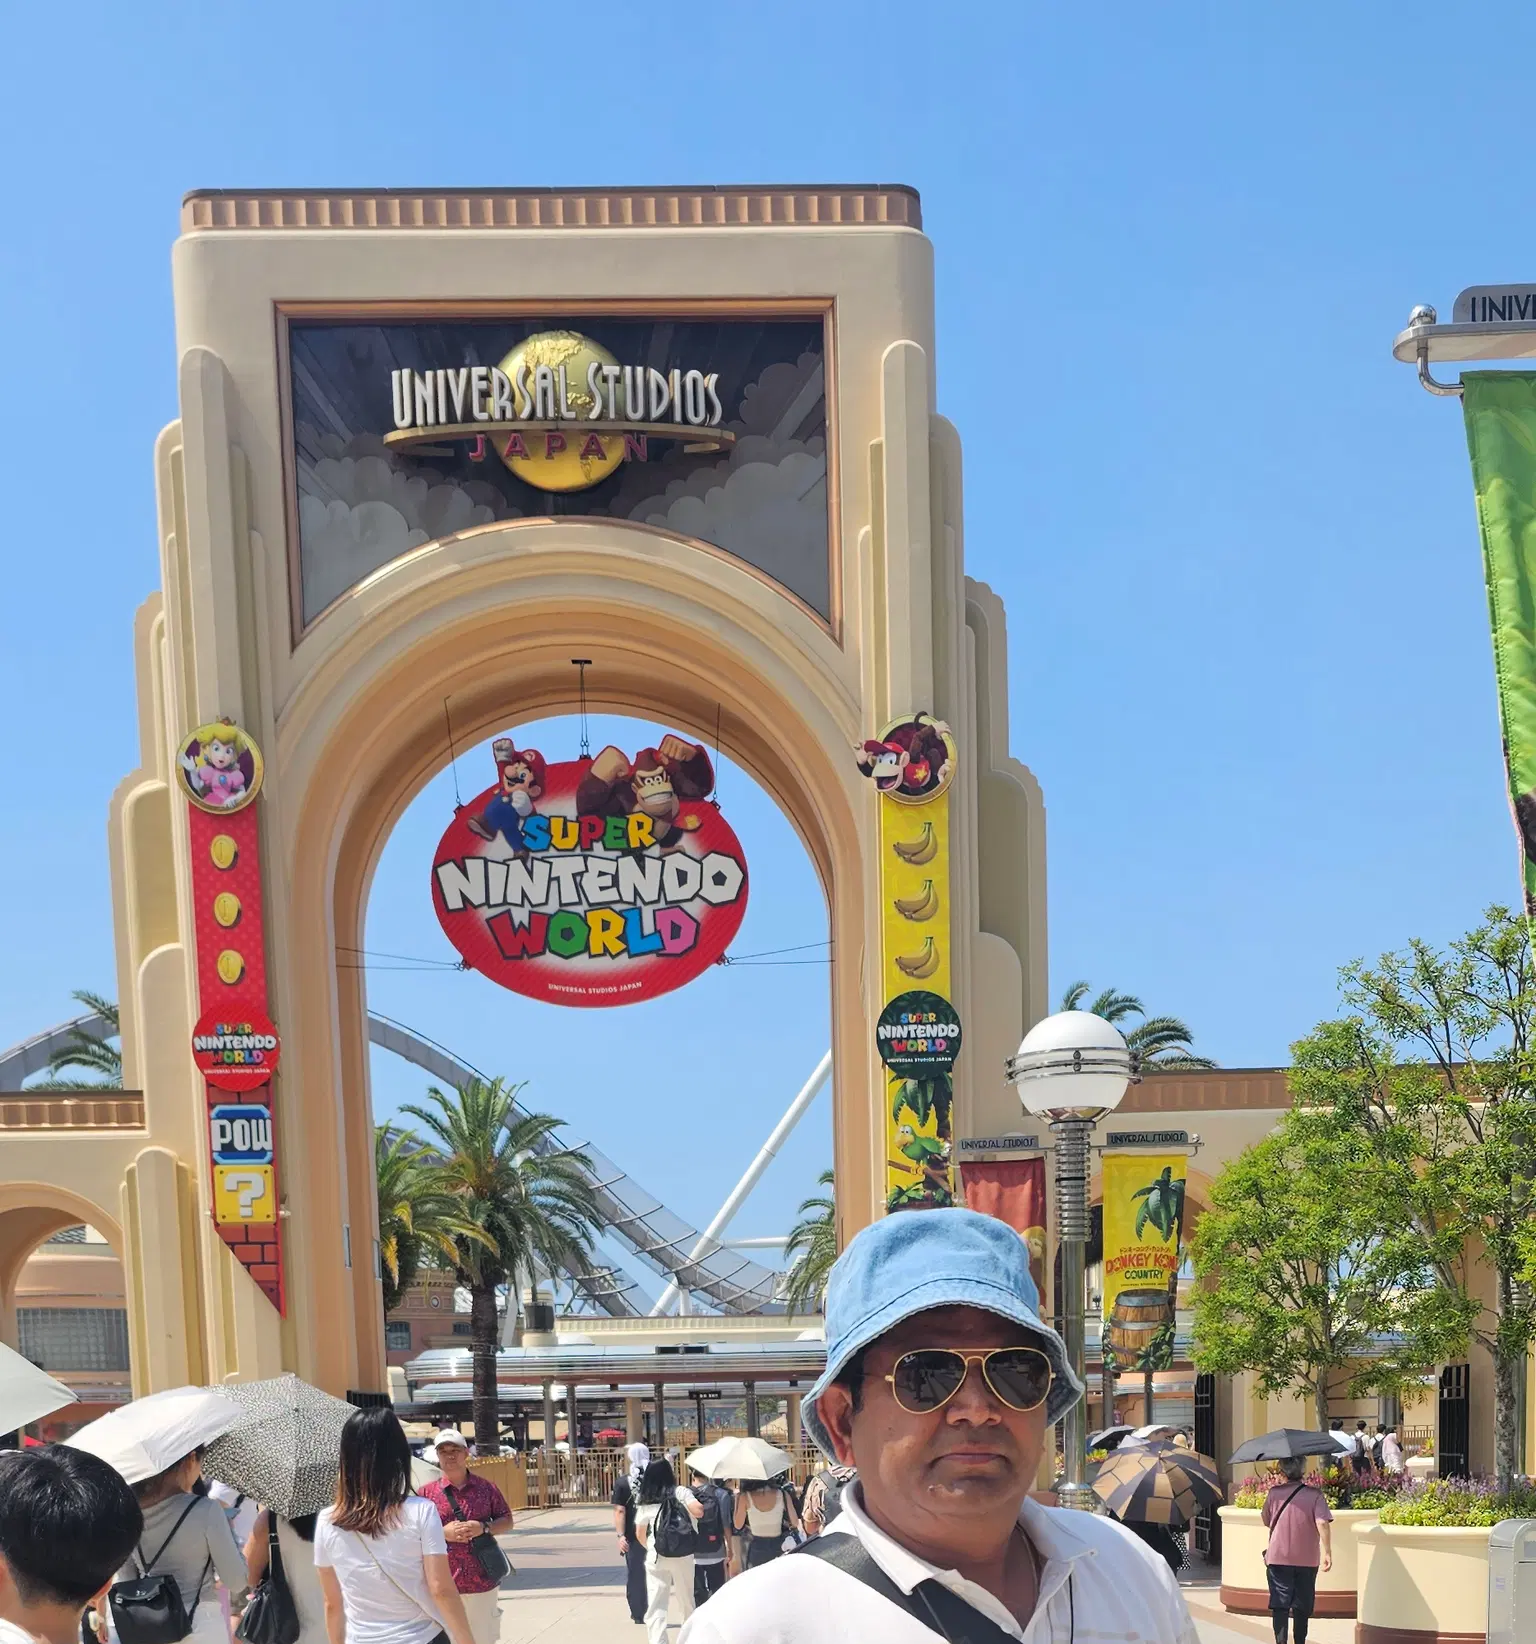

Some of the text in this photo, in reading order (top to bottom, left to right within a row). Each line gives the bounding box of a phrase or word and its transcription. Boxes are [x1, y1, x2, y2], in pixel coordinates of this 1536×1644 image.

[1471, 294, 1536, 322] UNIV
[391, 361, 723, 428] UNIVERSAL STUDIOS
[469, 432, 648, 462] JAPAN
[521, 812, 657, 852] SUPER
[433, 851, 746, 912] NINTENDO
[486, 906, 700, 960] WORLD
[548, 981, 642, 994] UNIVERSAL STUDIOS JAPAN
[901, 1012, 936, 1024] SUPER
[215, 1023, 253, 1035] SUPER
[878, 1024, 959, 1039] NINTENDO
[193, 1035, 277, 1051] NINTENDO
[890, 1038, 947, 1053] WORLD
[211, 1049, 265, 1065] WORLD
[210, 1118, 273, 1151] POW
[1110, 1132, 1184, 1144] UNIVERSAL STUDIOS
[961, 1137, 1034, 1150] UNIVERSAL STUDIOS
[1106, 1252, 1178, 1274] DONKEY KON
[1124, 1269, 1164, 1280] COUNTRY
